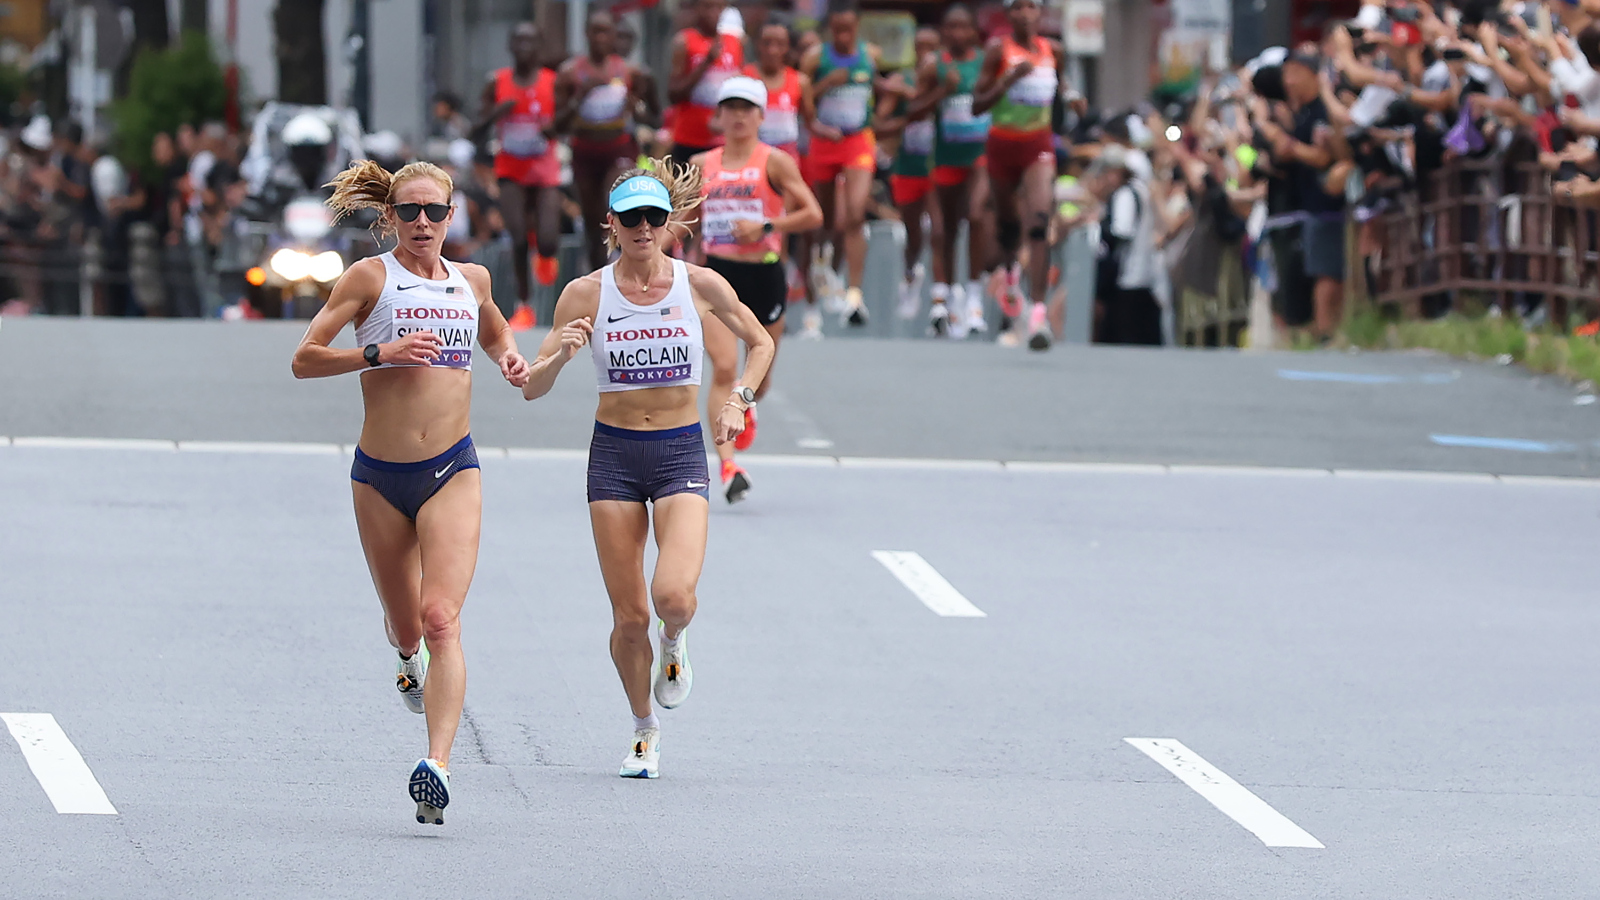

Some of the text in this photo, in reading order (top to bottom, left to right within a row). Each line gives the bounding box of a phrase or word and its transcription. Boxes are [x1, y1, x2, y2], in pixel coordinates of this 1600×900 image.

[629, 180, 657, 192] USA
[394, 307, 475, 320] HONDA
[605, 326, 689, 342] HONDA
[609, 345, 688, 367] McCLAIN
